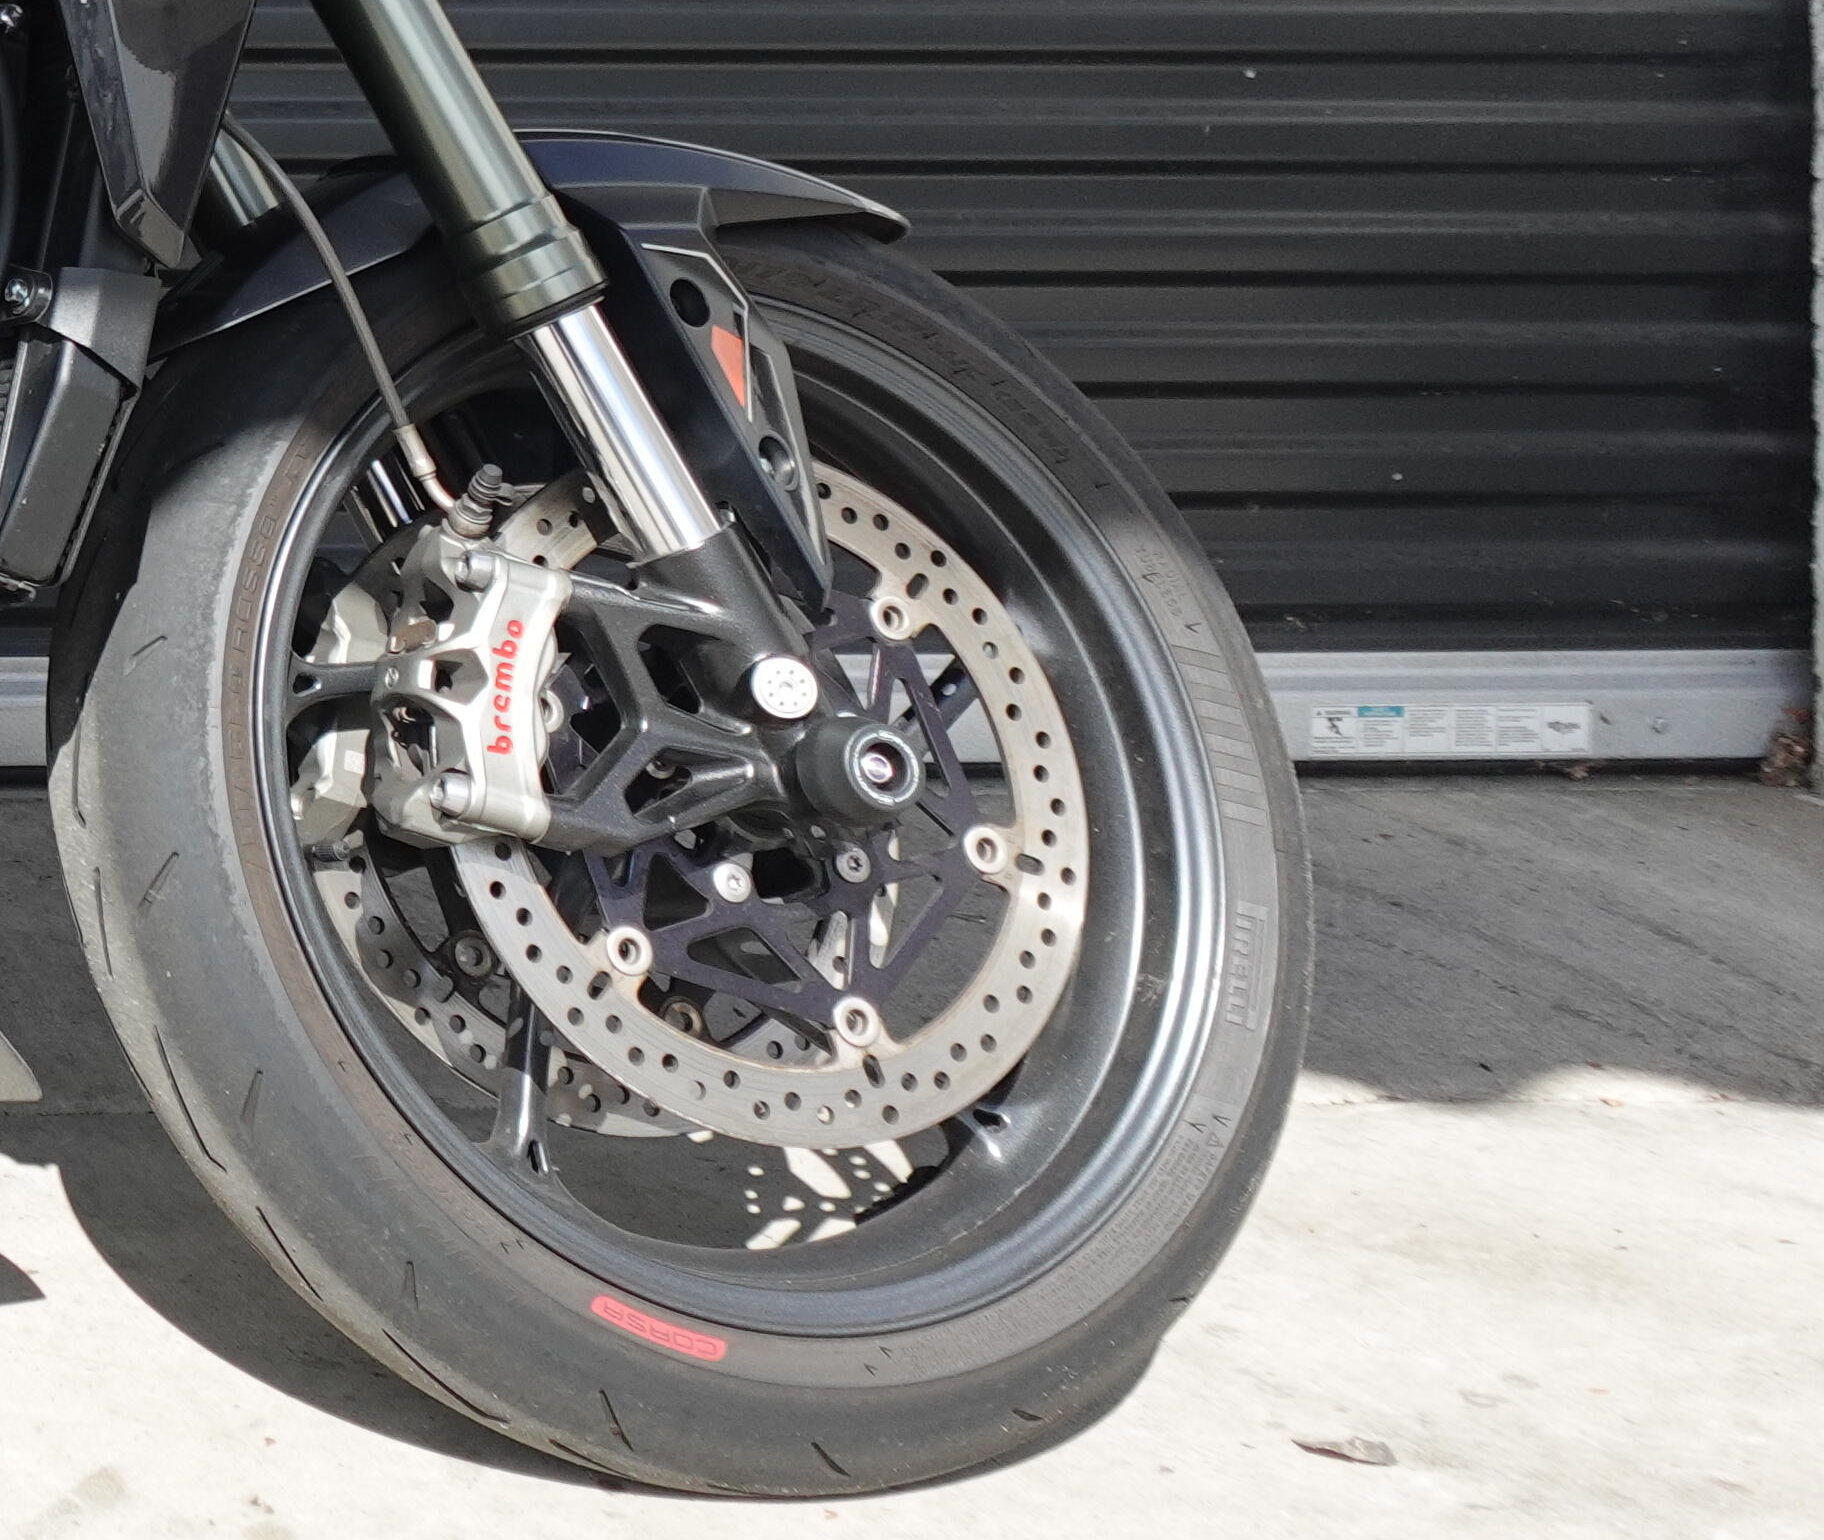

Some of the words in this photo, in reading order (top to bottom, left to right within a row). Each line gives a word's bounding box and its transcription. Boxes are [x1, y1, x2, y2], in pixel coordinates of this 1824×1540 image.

[486, 619, 525, 756] brembo
[1220, 901, 1268, 1031] PIRELLI
[603, 1300, 719, 1357] CORSA
